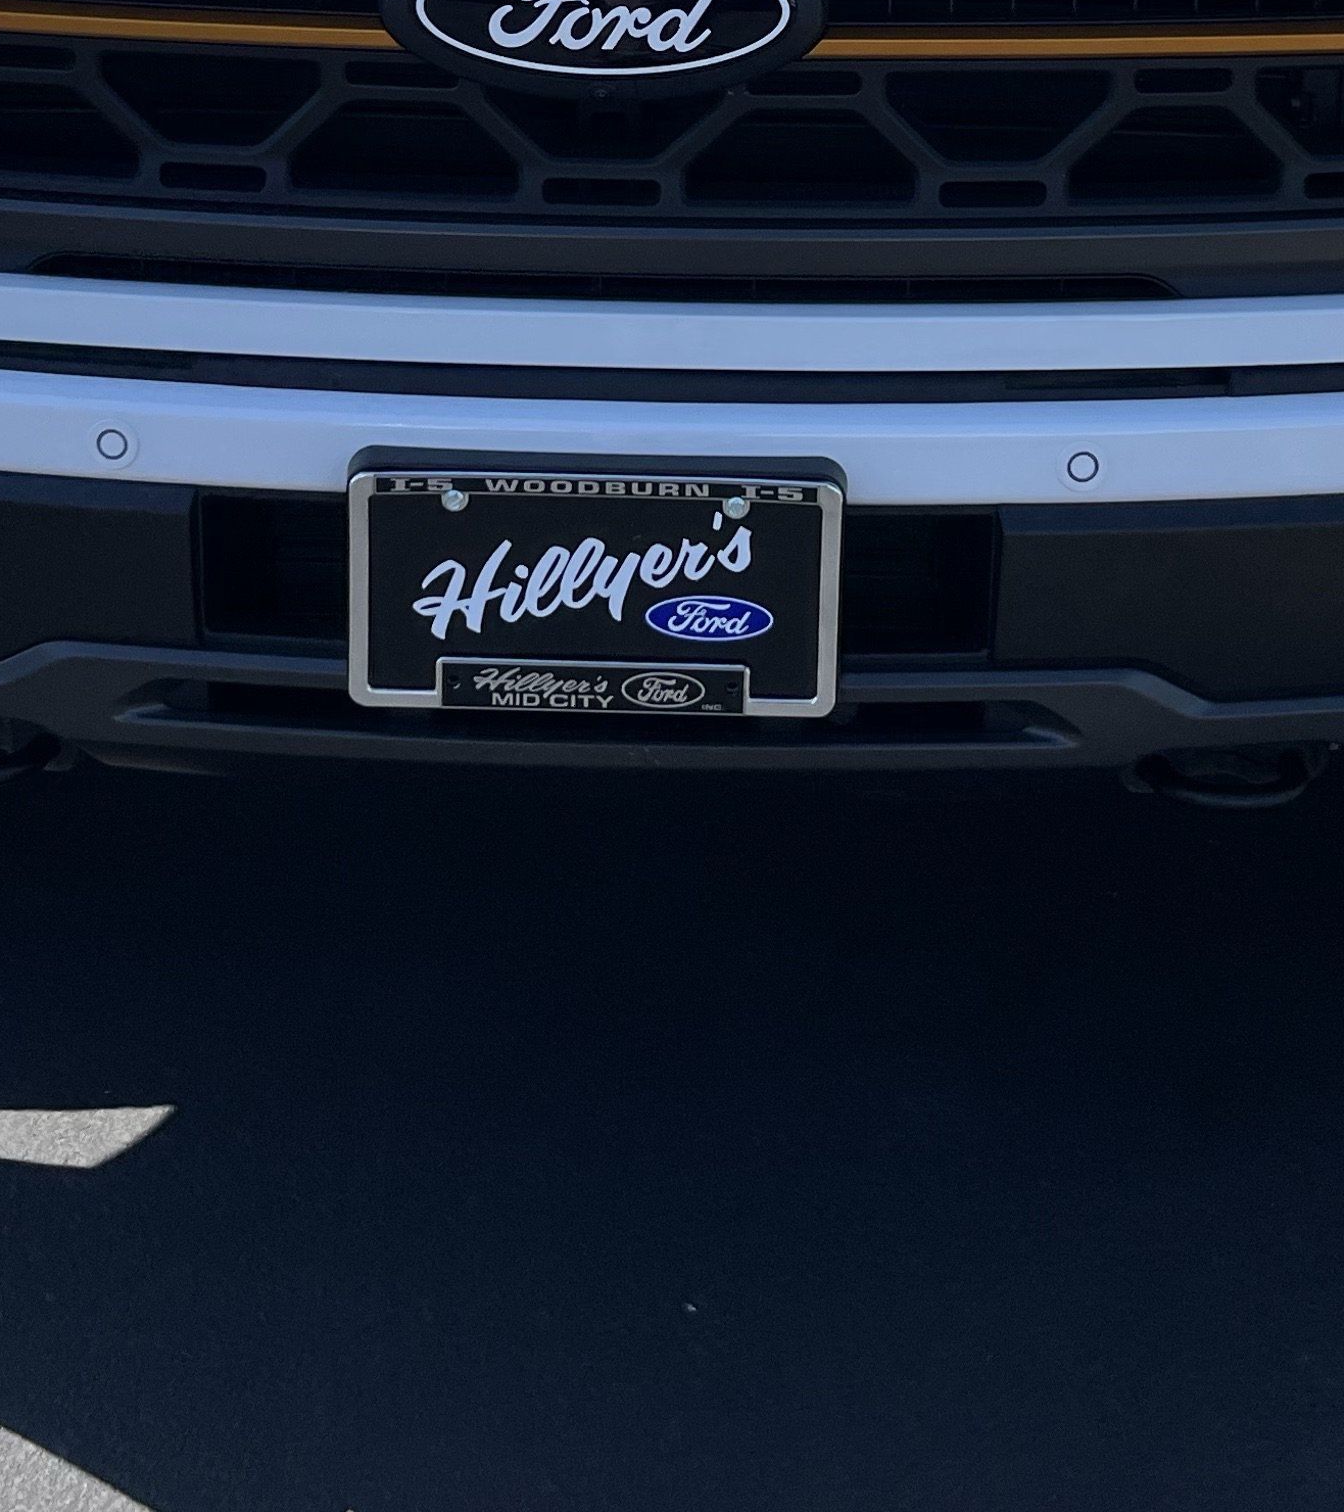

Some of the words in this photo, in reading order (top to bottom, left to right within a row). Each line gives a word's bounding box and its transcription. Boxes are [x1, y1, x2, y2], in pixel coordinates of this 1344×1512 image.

[390, 477, 454, 492] I-5
[485, 478, 710, 498] WOODBURN
[740, 484, 804, 502] I-5
[412, 511, 752, 640] Hillyer's
[667, 602, 750, 635] Ford
[473, 667, 609, 698] Hillyer's
[637, 677, 689, 703] Ford
[491, 692, 540, 707] MID
[549, 693, 614, 709] CITY
